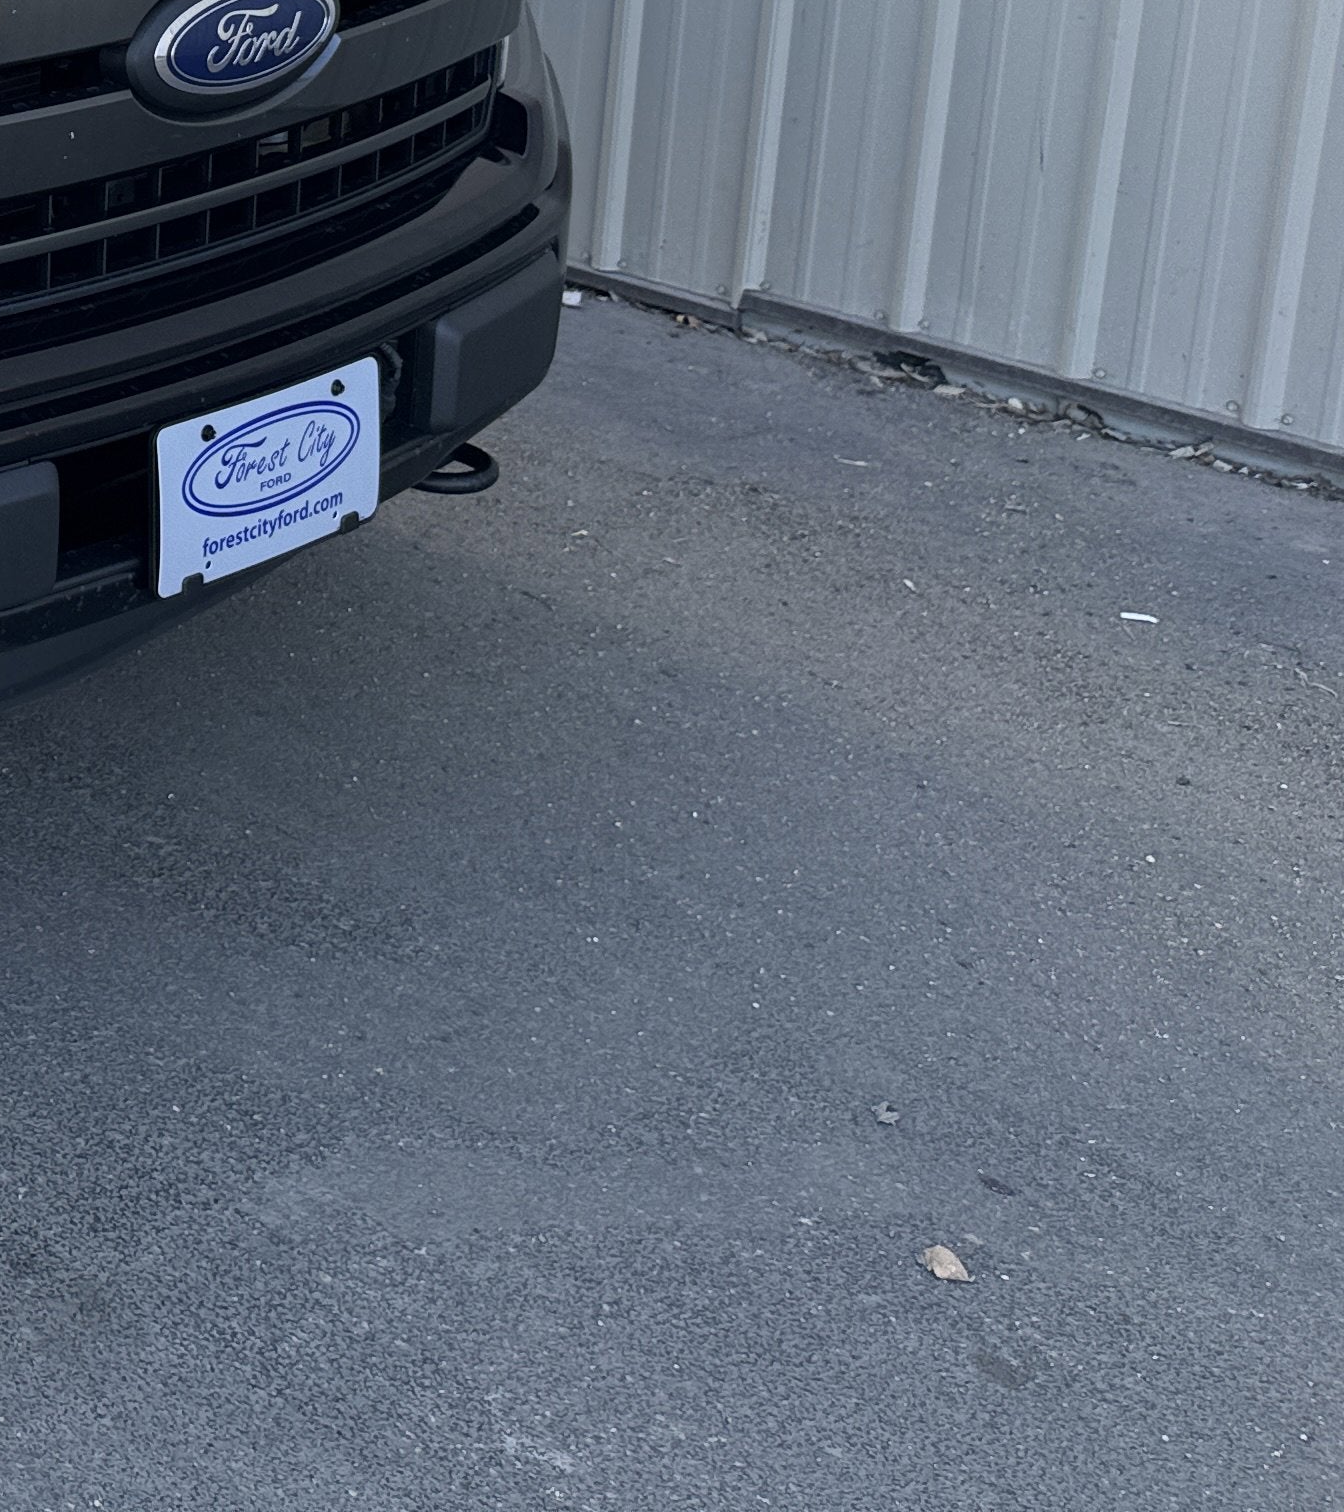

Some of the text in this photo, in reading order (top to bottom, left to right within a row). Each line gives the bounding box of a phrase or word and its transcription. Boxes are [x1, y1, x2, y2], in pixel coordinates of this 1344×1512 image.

[206, 3, 302, 73] Ford
[214, 420, 336, 490] Forest City
[260, 472, 292, 491] FORD
[202, 490, 344, 559] forestcityford.com
